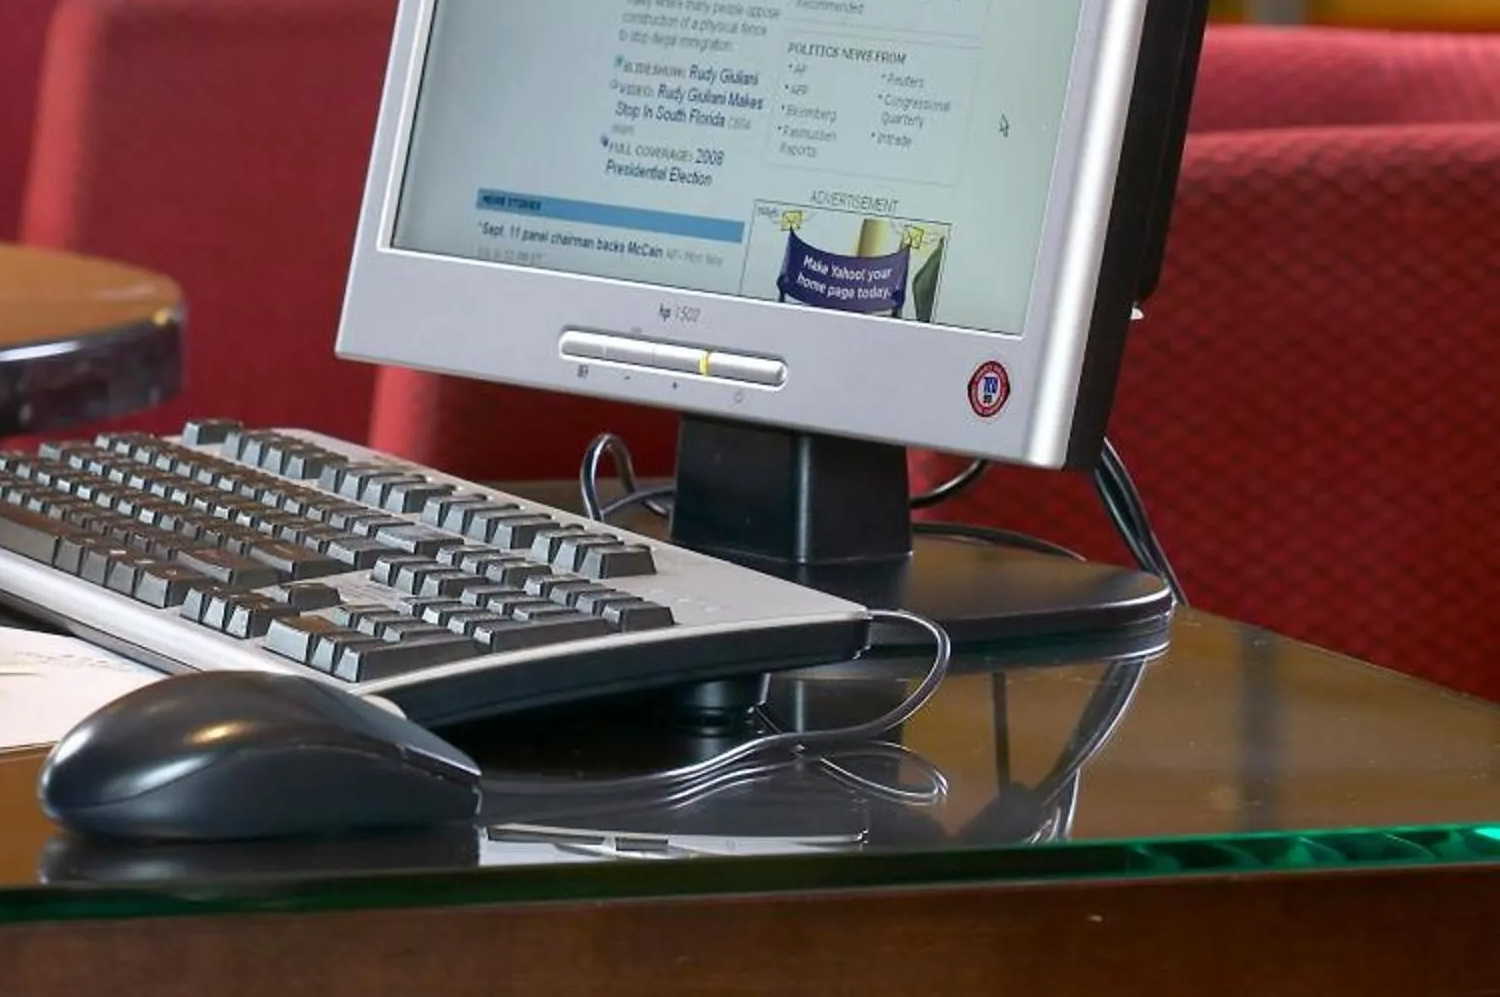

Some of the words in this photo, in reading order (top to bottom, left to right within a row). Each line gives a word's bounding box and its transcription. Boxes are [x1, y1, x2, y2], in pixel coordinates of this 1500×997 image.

[712, 2, 744, 17] people
[746, 6, 782, 21] oppose
[700, 18, 739, 35] physical
[740, 21, 768, 36] fence
[786, 41, 840, 59] POLITICS
[841, 48, 874, 64] NEWS
[874, 51, 908, 65] FROM
[688, 63, 716, 85] Rudy
[718, 67, 760, 87] Giuliani
[886, 71, 925, 89] Reuters
[657, 83, 686, 104] Rudy
[687, 86, 727, 105] Giuliani
[727, 92, 764, 110] Makes
[884, 93, 952, 113] Congressional
[615, 101, 640, 121] Stop
[642, 103, 653, 120] In
[655, 104, 687, 123] South
[689, 108, 726, 129] Florida
[786, 103, 838, 124] Bloomberg
[880, 110, 925, 130] Quarterly
[782, 124, 838, 142] Rasmussen
[694, 146, 725, 166] 2008
[779, 140, 818, 159] Reports
[605, 158, 668, 182] Presidential
[669, 165, 713, 187] Election
[809, 188, 900, 214] ADVERTISEMENT
[509, 223, 521, 239] 11
[521, 228, 548, 243] panel
[550, 232, 595, 250] chairman
[596, 238, 626, 254] backs
[627, 240, 664, 259] McCain
[803, 254, 830, 276] Make
[866, 267, 893, 284] your
[796, 274, 827, 294] home
[827, 284, 855, 301] page
[856, 286, 893, 301] today.
[659, 302, 671, 322] hp
